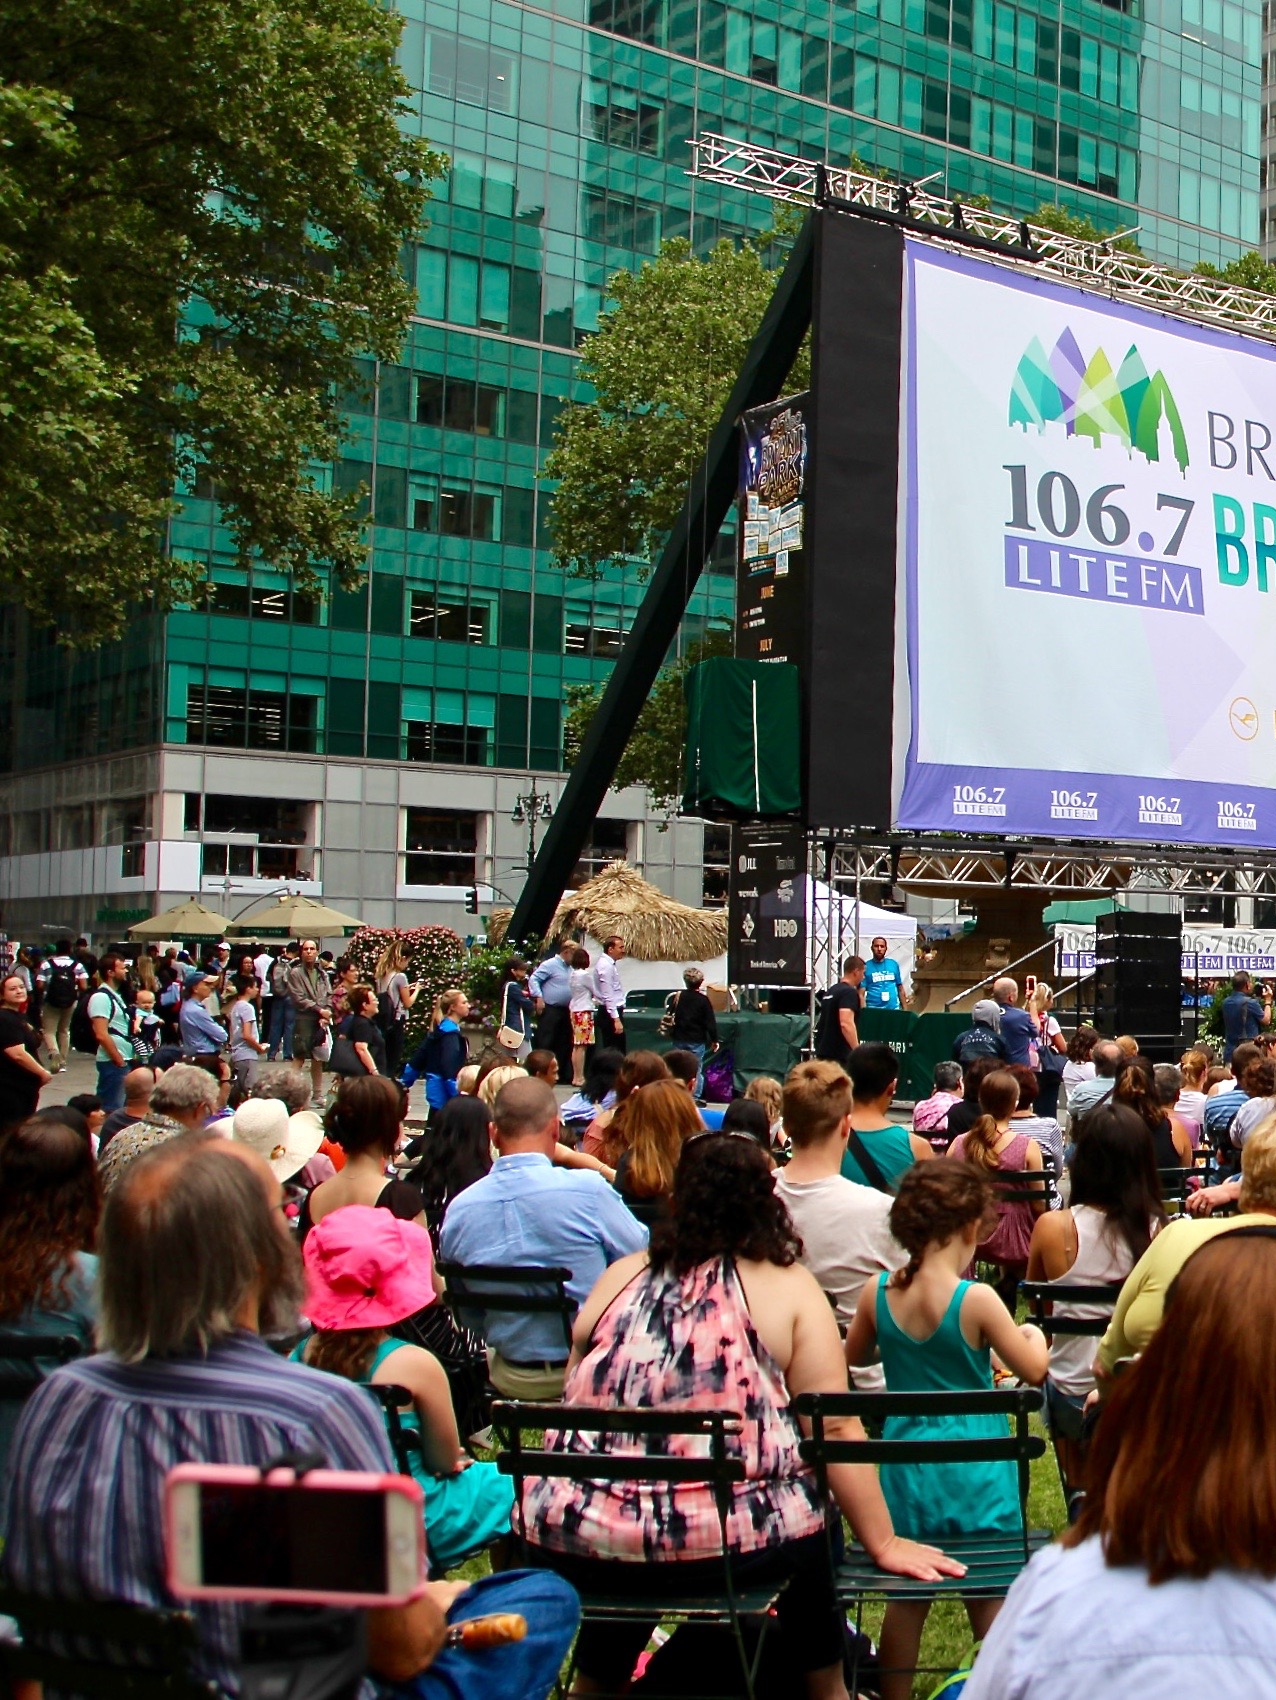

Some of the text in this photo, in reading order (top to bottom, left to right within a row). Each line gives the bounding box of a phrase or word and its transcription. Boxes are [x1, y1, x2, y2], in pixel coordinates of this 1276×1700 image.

[758, 450, 800, 496] PARK
[1002, 464, 1195, 556] 106.7
[953, 785, 1006, 804] 106.7
[1051, 790, 1098, 808] 106.7
[1138, 795, 1181, 813] 106.7
[1217, 800, 1255, 818] 106.7
[747, 858, 757, 870] JLL
[774, 919, 798, 938] HBO
[1182, 934, 1223, 954] 06.7
[1226, 936, 1275, 954] 106.7
[1062, 952, 1095, 968] LITE
